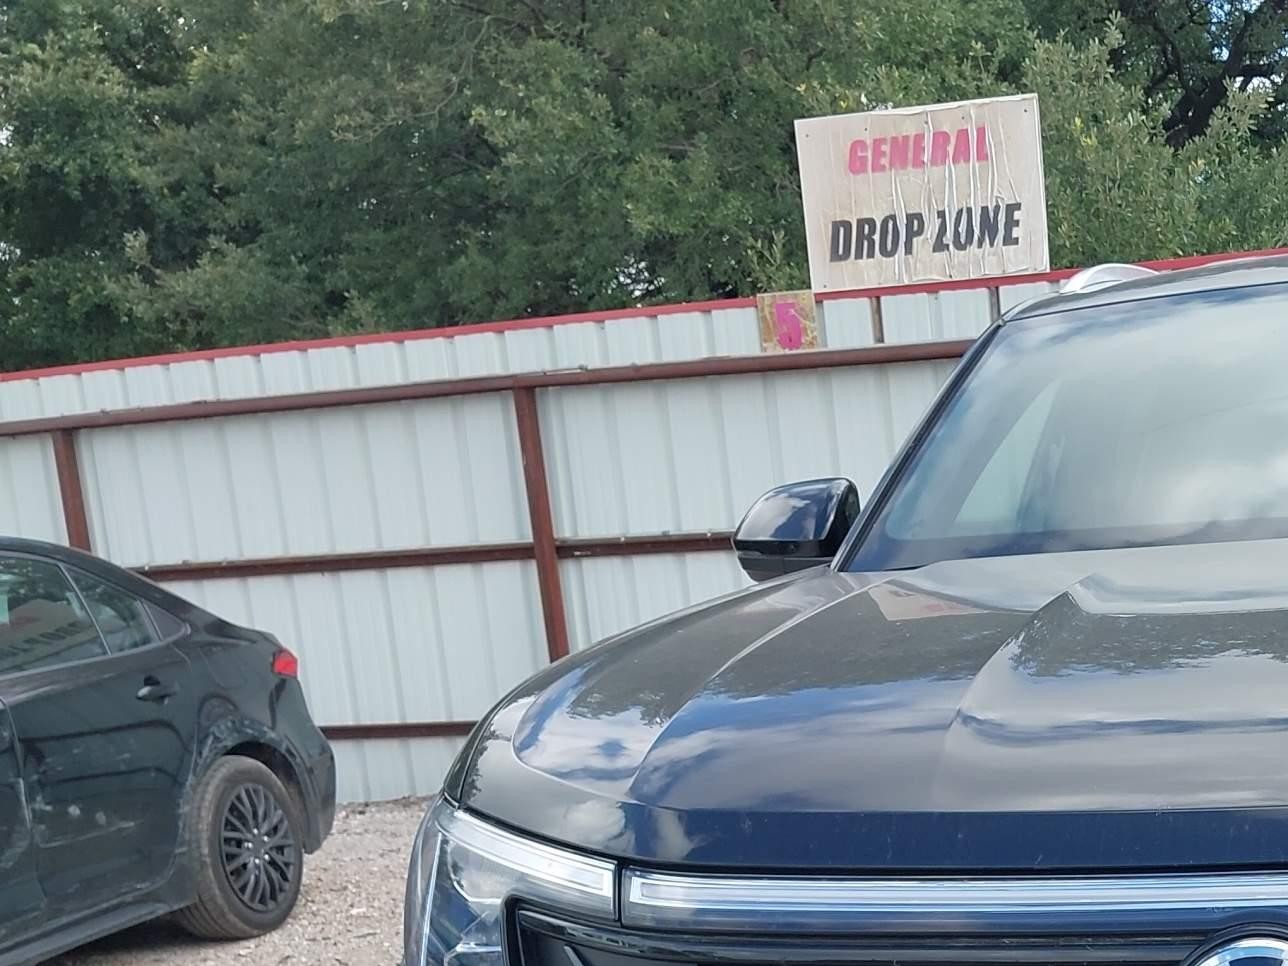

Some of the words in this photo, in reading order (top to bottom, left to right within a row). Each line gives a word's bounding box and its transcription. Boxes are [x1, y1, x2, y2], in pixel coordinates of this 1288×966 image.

[848, 124, 990, 175] GENERAL
[829, 210, 925, 263] DROP
[932, 201, 1022, 253] ZONE
